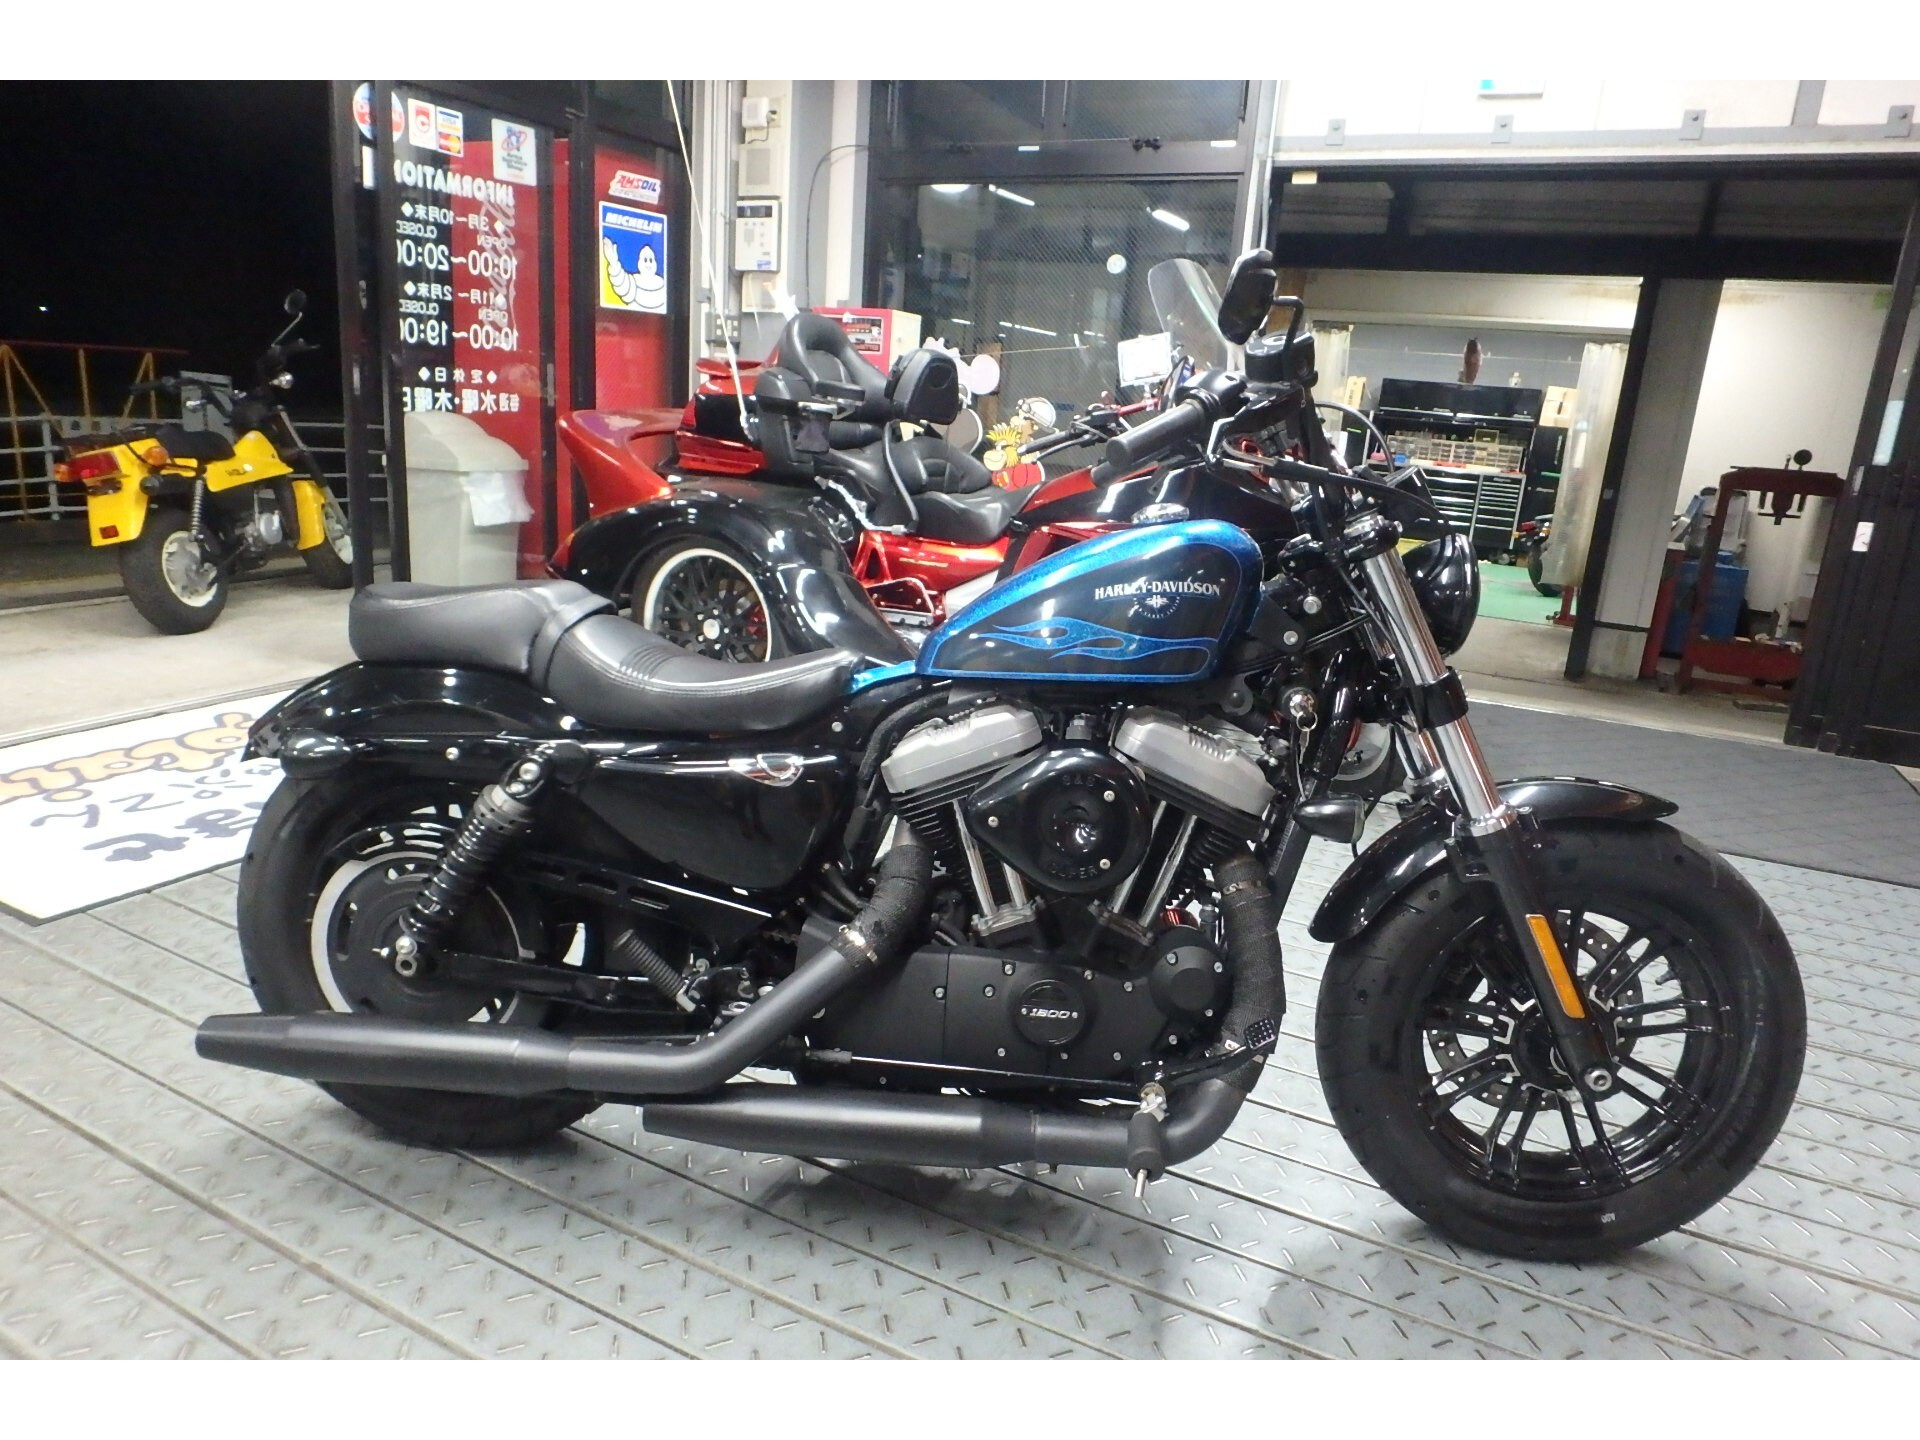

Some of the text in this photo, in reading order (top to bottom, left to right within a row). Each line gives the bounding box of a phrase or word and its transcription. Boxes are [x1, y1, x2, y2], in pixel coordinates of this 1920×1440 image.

[616, 174, 657, 193] AMSOIL
[605, 212, 663, 233] MICHELIN
[1094, 581, 1221, 600] HARLEY-DAVIDSON
